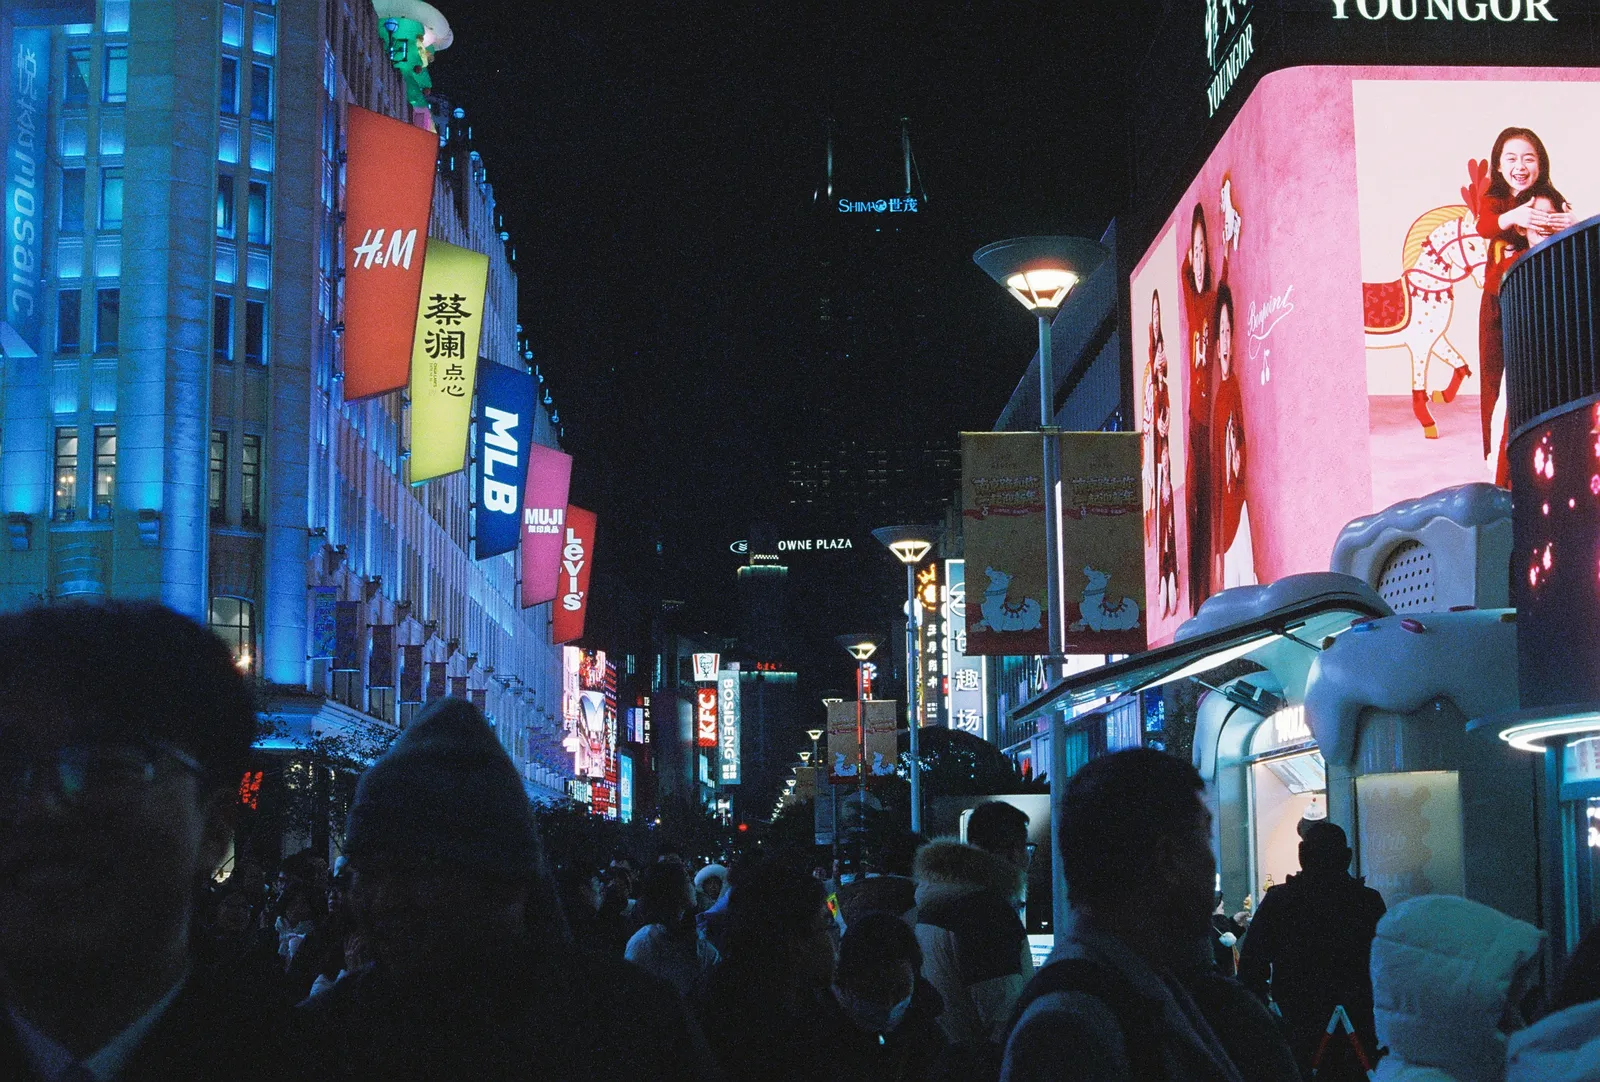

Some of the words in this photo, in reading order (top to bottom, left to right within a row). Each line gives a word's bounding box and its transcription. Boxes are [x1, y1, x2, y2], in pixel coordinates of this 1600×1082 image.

[1207, 23, 1254, 118] YOUNGOR
[12, 149, 37, 317] mosaic
[888, 197, 918, 213] 世茂
[353, 228, 418, 270] H&M
[483, 405, 519, 515] MLB
[524, 508, 563, 525] MUJI
[778, 540, 812, 550] OWNE
[816, 538, 853, 550] PLAZA
[563, 528, 584, 611] Levi's
[698, 693, 716, 741] KFC
[723, 678, 735, 760] BOSIDENG
